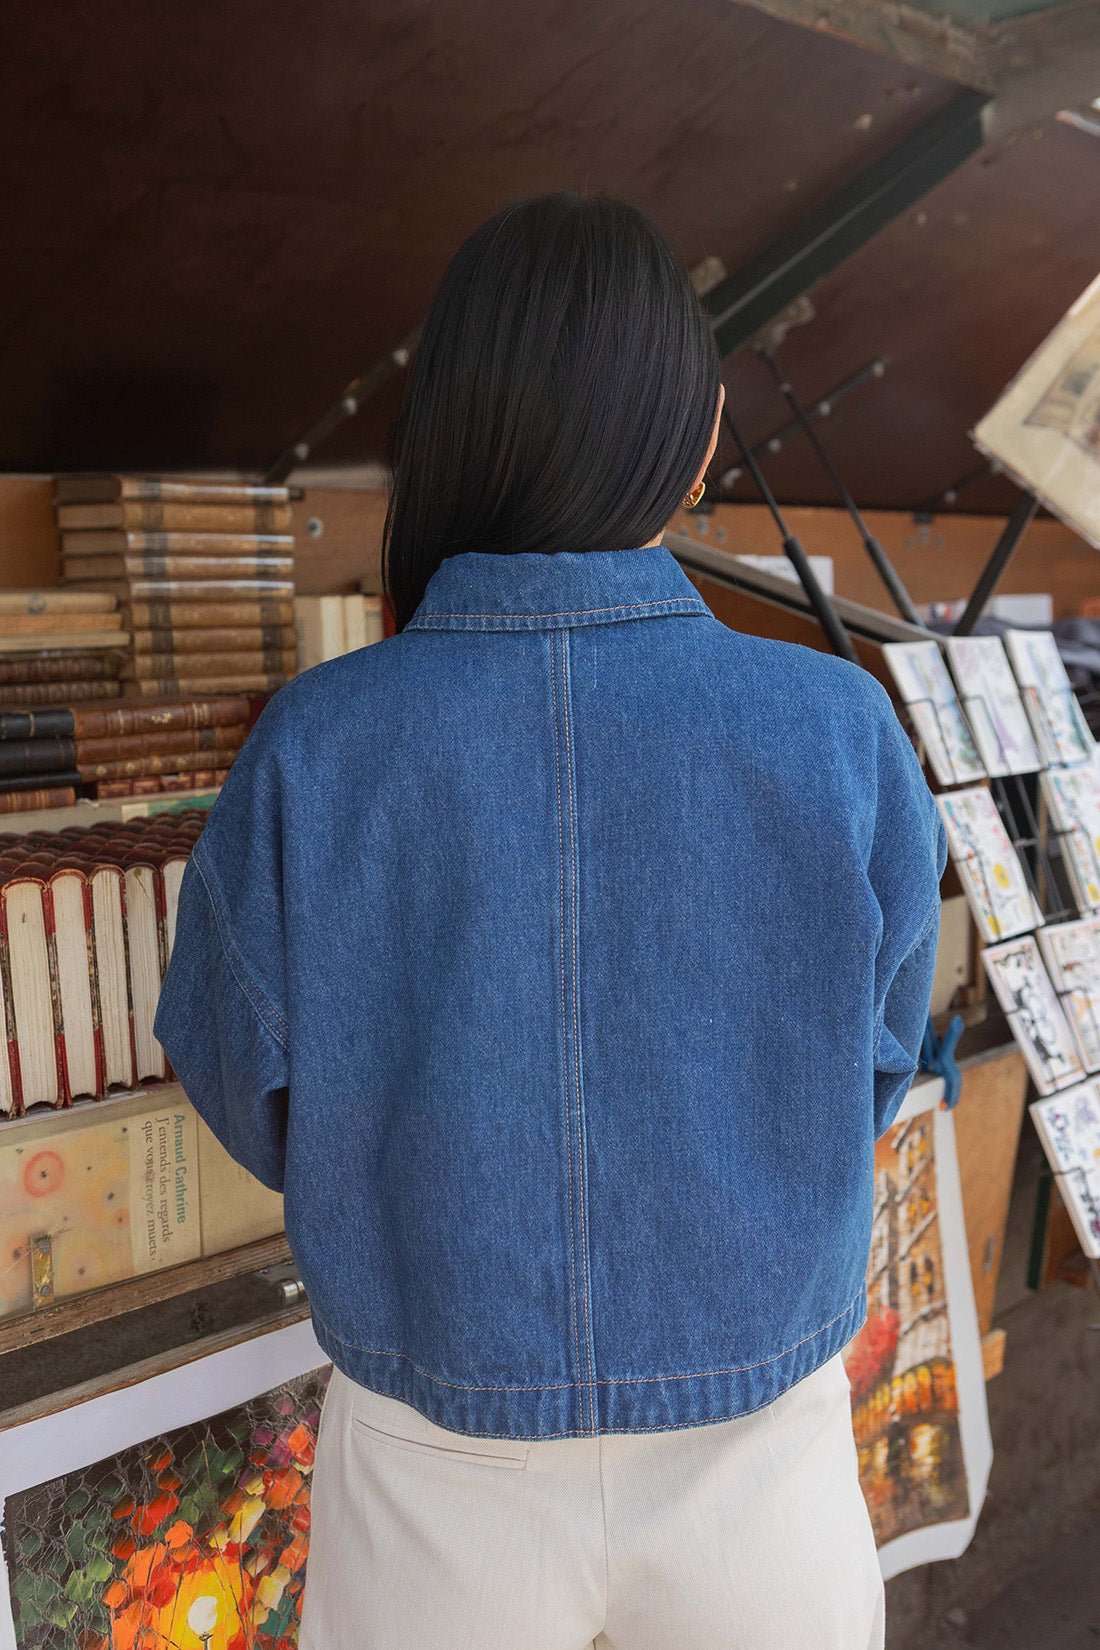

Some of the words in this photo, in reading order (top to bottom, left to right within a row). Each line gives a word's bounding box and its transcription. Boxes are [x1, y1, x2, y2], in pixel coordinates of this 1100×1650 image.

[141, 1120, 153, 1143] que
[156, 1117, 171, 1173] J'entends
[174, 1114, 187, 1163] Arnaud
[159, 1175, 171, 1196] des
[175, 1165, 187, 1224] Cathrine
[157, 1198, 174, 1243] regards
